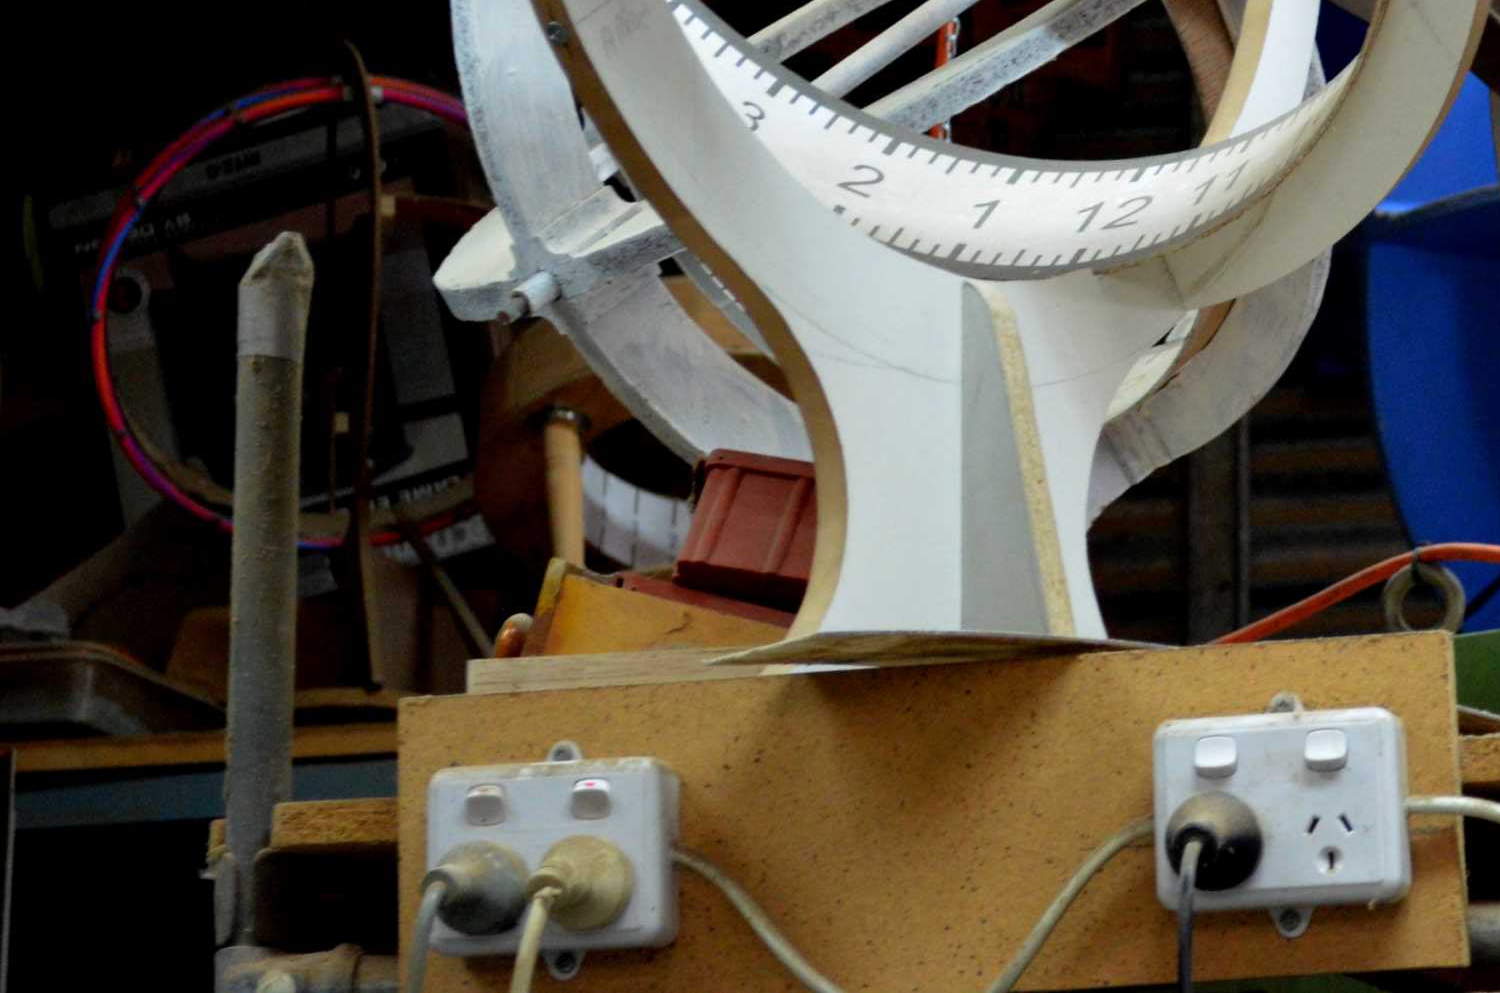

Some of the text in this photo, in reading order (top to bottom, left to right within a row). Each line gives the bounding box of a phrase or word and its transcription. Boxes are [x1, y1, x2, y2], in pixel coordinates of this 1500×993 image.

[741, 100, 1250, 234] 3 2 1 12 11
